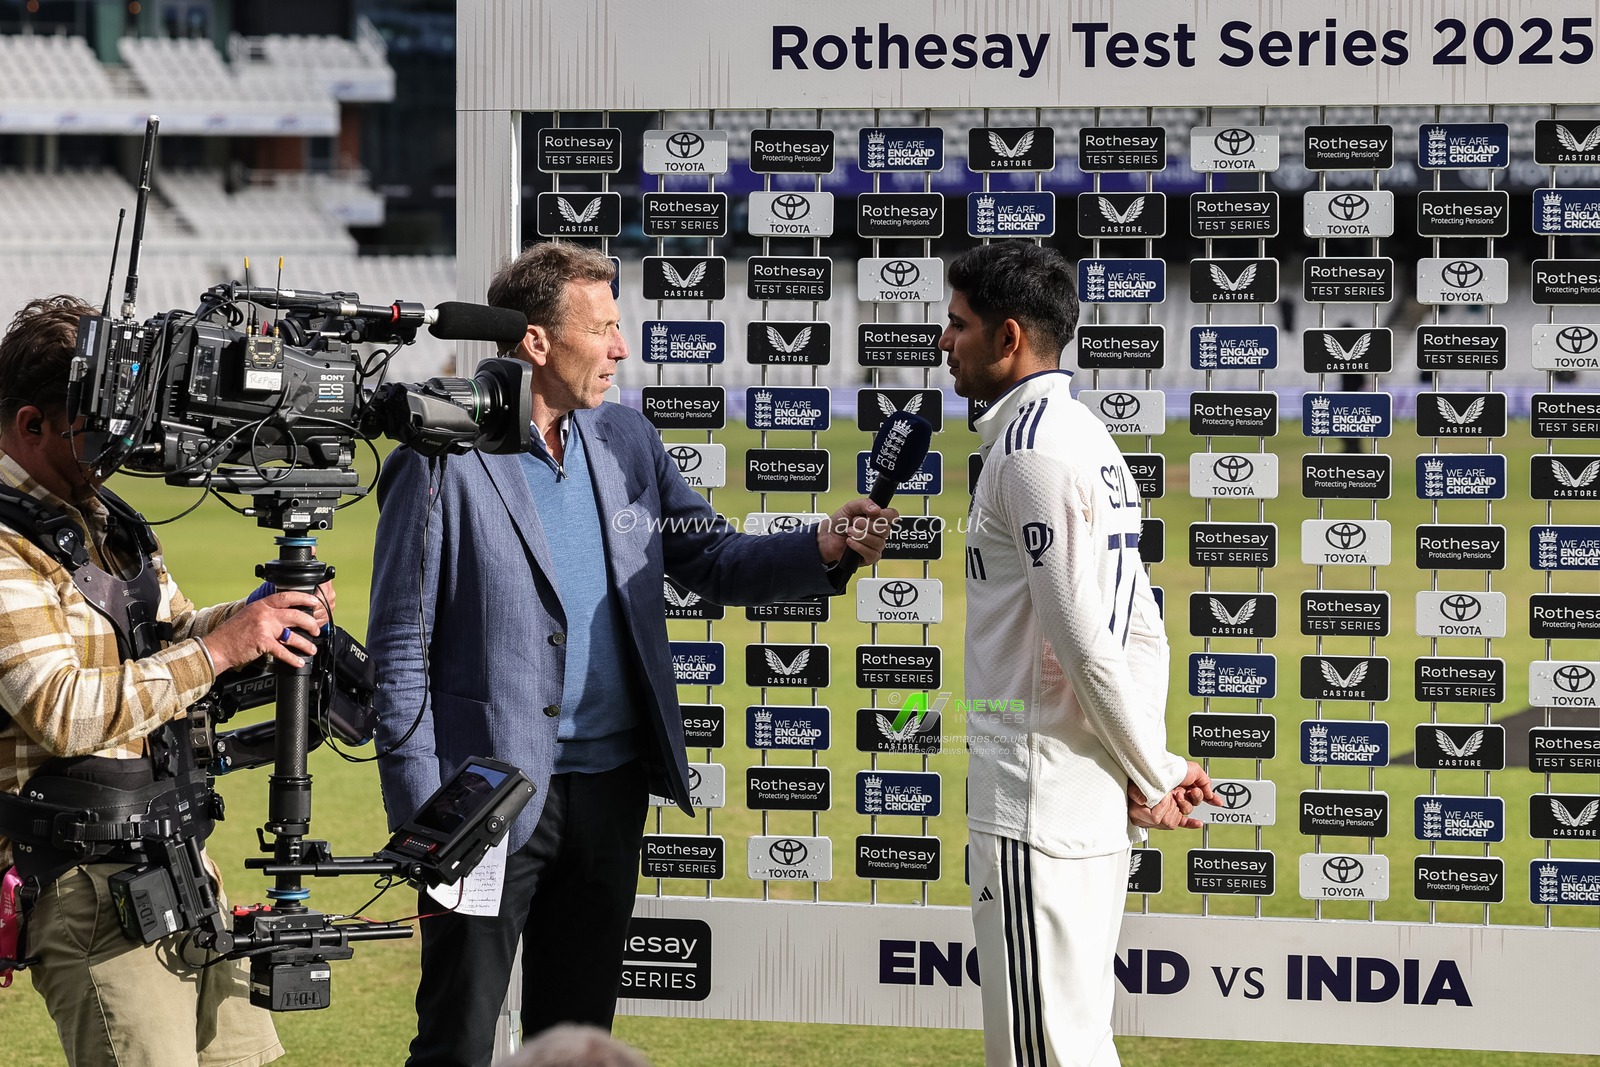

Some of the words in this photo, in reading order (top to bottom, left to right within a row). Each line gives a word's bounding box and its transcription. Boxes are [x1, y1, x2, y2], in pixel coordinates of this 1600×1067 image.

[773, 23, 1050, 78] Rothesay
[1072, 23, 1195, 68] Test
[1219, 19, 1408, 67] Series
[1433, 18, 1593, 65] 2025
[545, 136, 613, 150] Rothesay
[888, 140, 903, 149] WE
[905, 141, 925, 149] ARE
[1449, 137, 1466, 145] WE
[1468, 137, 1488, 145] ARE
[888, 148, 935, 157] ENGLAND
[1450, 145, 1500, 154] ENGLAND
[545, 155, 571, 164] TEST
[576, 156, 613, 164] SERIES
[887, 157, 929, 166] CRICKET
[1449, 154, 1493, 163] CRICKET
[665, 162, 705, 171] TOYOTA
[1213, 160, 1255, 169] TOYOTA
[650, 200, 719, 215] Rothesay
[1423, 203, 1502, 220] Rothesay
[650, 220, 676, 229] TEST
[681, 220, 719, 230] SERIES
[1431, 217, 1464, 226] Protecting
[770, 224, 810, 233] TOYOTA
[1327, 225, 1370, 234] TOYOTA
[1108, 272, 1124, 281] WE
[1126, 273, 1145, 281] ARE
[1108, 281, 1156, 290] ENGLAND
[879, 291, 920, 300] TOYOTA
[1108, 289, 1150, 298] CRICKET
[1440, 292, 1483, 301] TOYOTA
[670, 334, 686, 342] WE
[688, 334, 706, 342] ARE
[864, 331, 935, 346] Rothesay
[670, 341, 717, 351] ENGLAND
[1082, 337, 1159, 353] Rothesay
[670, 350, 711, 359] CRICKET
[865, 351, 892, 360] TEST
[896, 351, 935, 361] SERIES
[1090, 351, 1122, 359] Protecting
[1555, 358, 1599, 367] TOYOTA
[646, 397, 720, 414] Rothesay
[654, 411, 685, 419] Protecting
[1106, 424, 1141, 432] OYOTA
[876, 454, 896, 470] ECB
[750, 460, 824, 476] Rothesay
[1446, 469, 1463, 477] WE
[1465, 469, 1485, 477] ARE
[757, 474, 788, 482] Protecting
[1306, 466, 1385, 483] Rothesay
[1314, 480, 1347, 489] Protecting
[1446, 477, 1496, 486] ENGLAND
[1212, 486, 1254, 495] TOYOTA
[1446, 486, 1490, 494] CRICKET
[1195, 531, 1269, 547] Rothesay
[1196, 552, 1224, 561] TEST
[1228, 552, 1268, 562] SERIES
[1324, 553, 1367, 563] TOYOTA
[753, 606, 779, 614] TEST
[784, 606, 822, 616] SERIES
[878, 611, 919, 620] TOYOTA
[1439, 625, 1482, 635] TOYOTA
[350, 644, 366, 662] PRO
[862, 653, 933, 668] Rothesay
[1218, 667, 1235, 676] WE
[1237, 667, 1256, 676] ARE
[1421, 666, 1496, 682] Rothesay
[863, 673, 890, 682] TEST
[894, 674, 933, 683] SERIES
[1218, 675, 1267, 685] ENGLAND
[1218, 683, 1262, 693] CRICKET
[1323, 689, 1365, 697] CASTORE
[1422, 686, 1450, 696] TEST
[1455, 687, 1496, 697] SERIES
[1552, 696, 1596, 706] TOYOTA
[774, 720, 790, 728] WE
[792, 720, 811, 729] ARE
[775, 727, 822, 737] ENGLAND
[774, 736, 816, 745] CRICKET
[1330, 735, 1347, 744] WE
[1349, 736, 1369, 744] ARE
[1331, 743, 1380, 753] ENGLAND
[1330, 752, 1374, 761] CRICKET
[751, 778, 825, 794] Rothesay
[758, 792, 789, 801] Protecting
[1210, 813, 1252, 823] TOYOTA
[647, 843, 716, 859] Rothesay
[860, 846, 936, 864] Rothesay
[648, 863, 674, 872] TEST
[678, 864, 716, 873] SERIES
[868, 860, 899, 870] Protecting
[1194, 857, 1267, 874] Rothesay
[769, 869, 809, 878] TOYOTA
[1195, 878, 1222, 887] TEST
[1227, 879, 1267, 889] SERIES
[1322, 887, 1364, 897] TOYOTA
[621, 970, 696, 990] SERIES
[1211, 967, 1264, 999] vs
[1287, 955, 1472, 1006] INDIA
